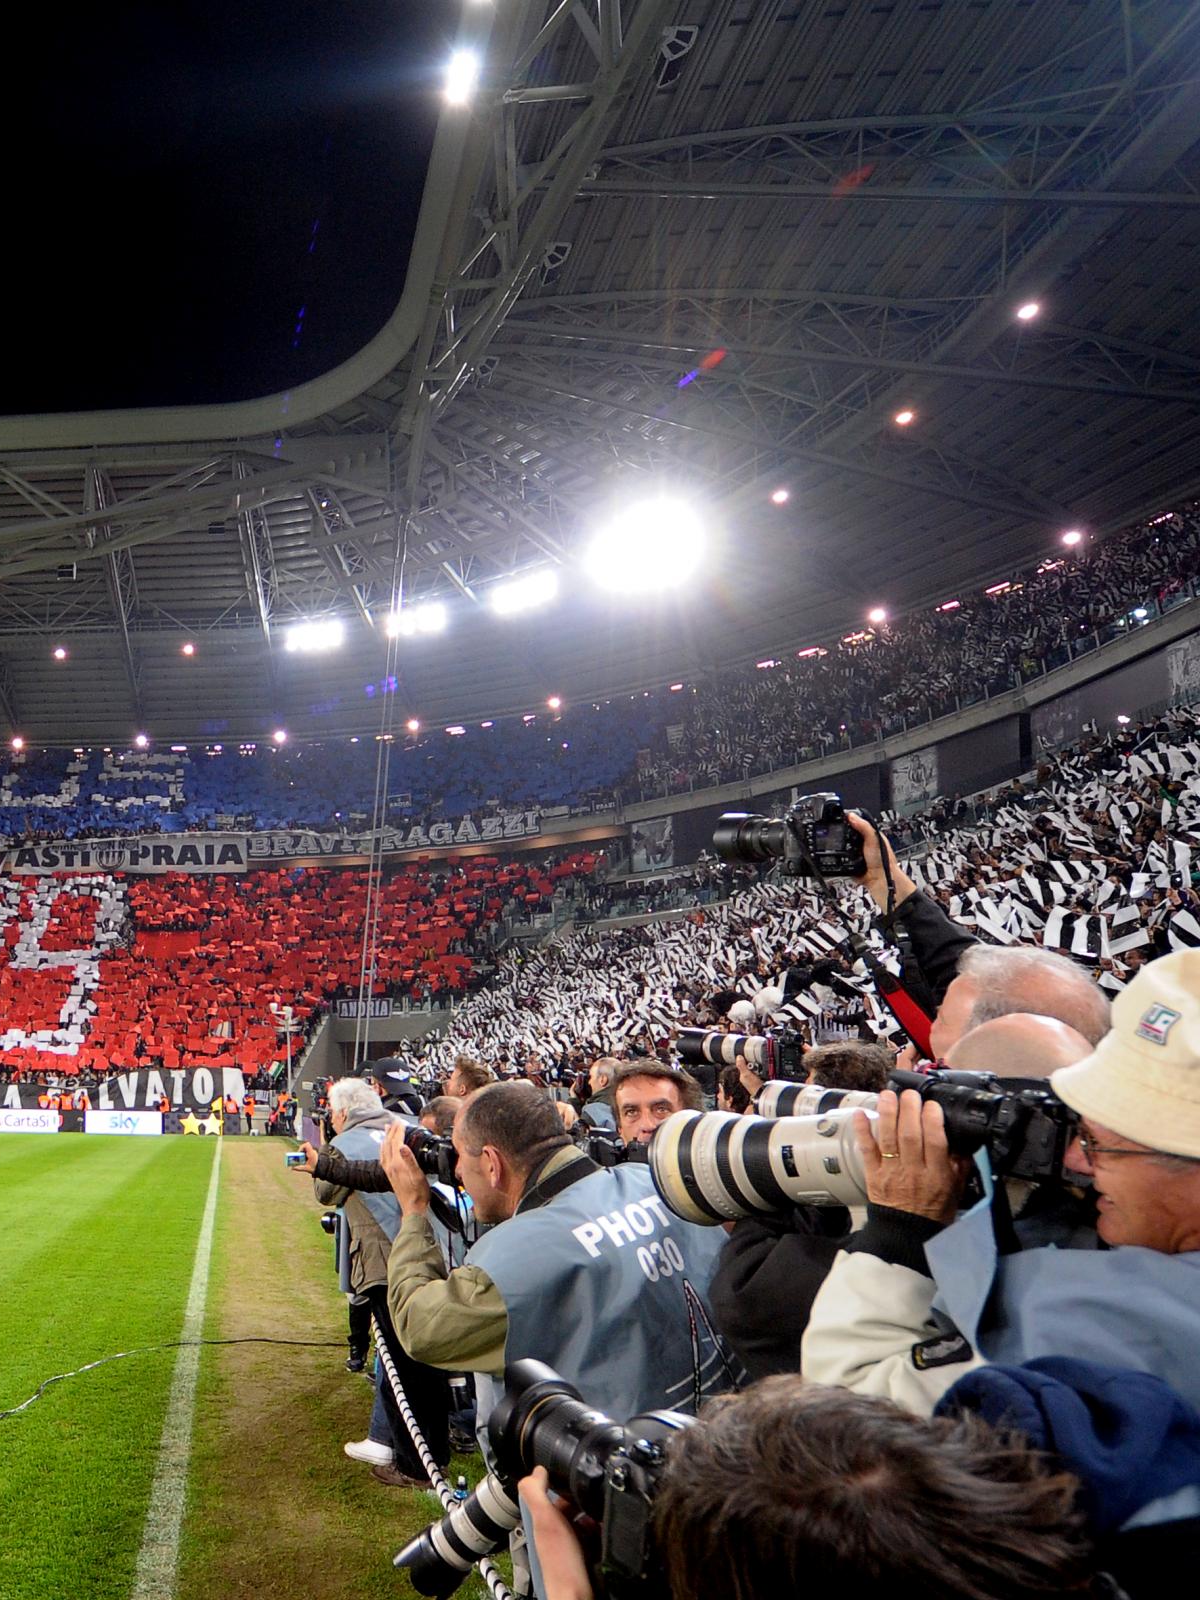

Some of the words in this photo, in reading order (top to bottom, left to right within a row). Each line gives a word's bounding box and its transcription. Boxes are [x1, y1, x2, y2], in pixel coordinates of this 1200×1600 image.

[14, 843, 90, 868] ASTI
[129, 843, 244, 867] PRAIA
[339, 999, 389, 1018] ANDRIA
[4, 1112, 49, 1128] CartaSi
[108, 1114, 141, 1134] sky
[571, 1194, 671, 1259] PHOT
[636, 1236, 686, 1283] 030
